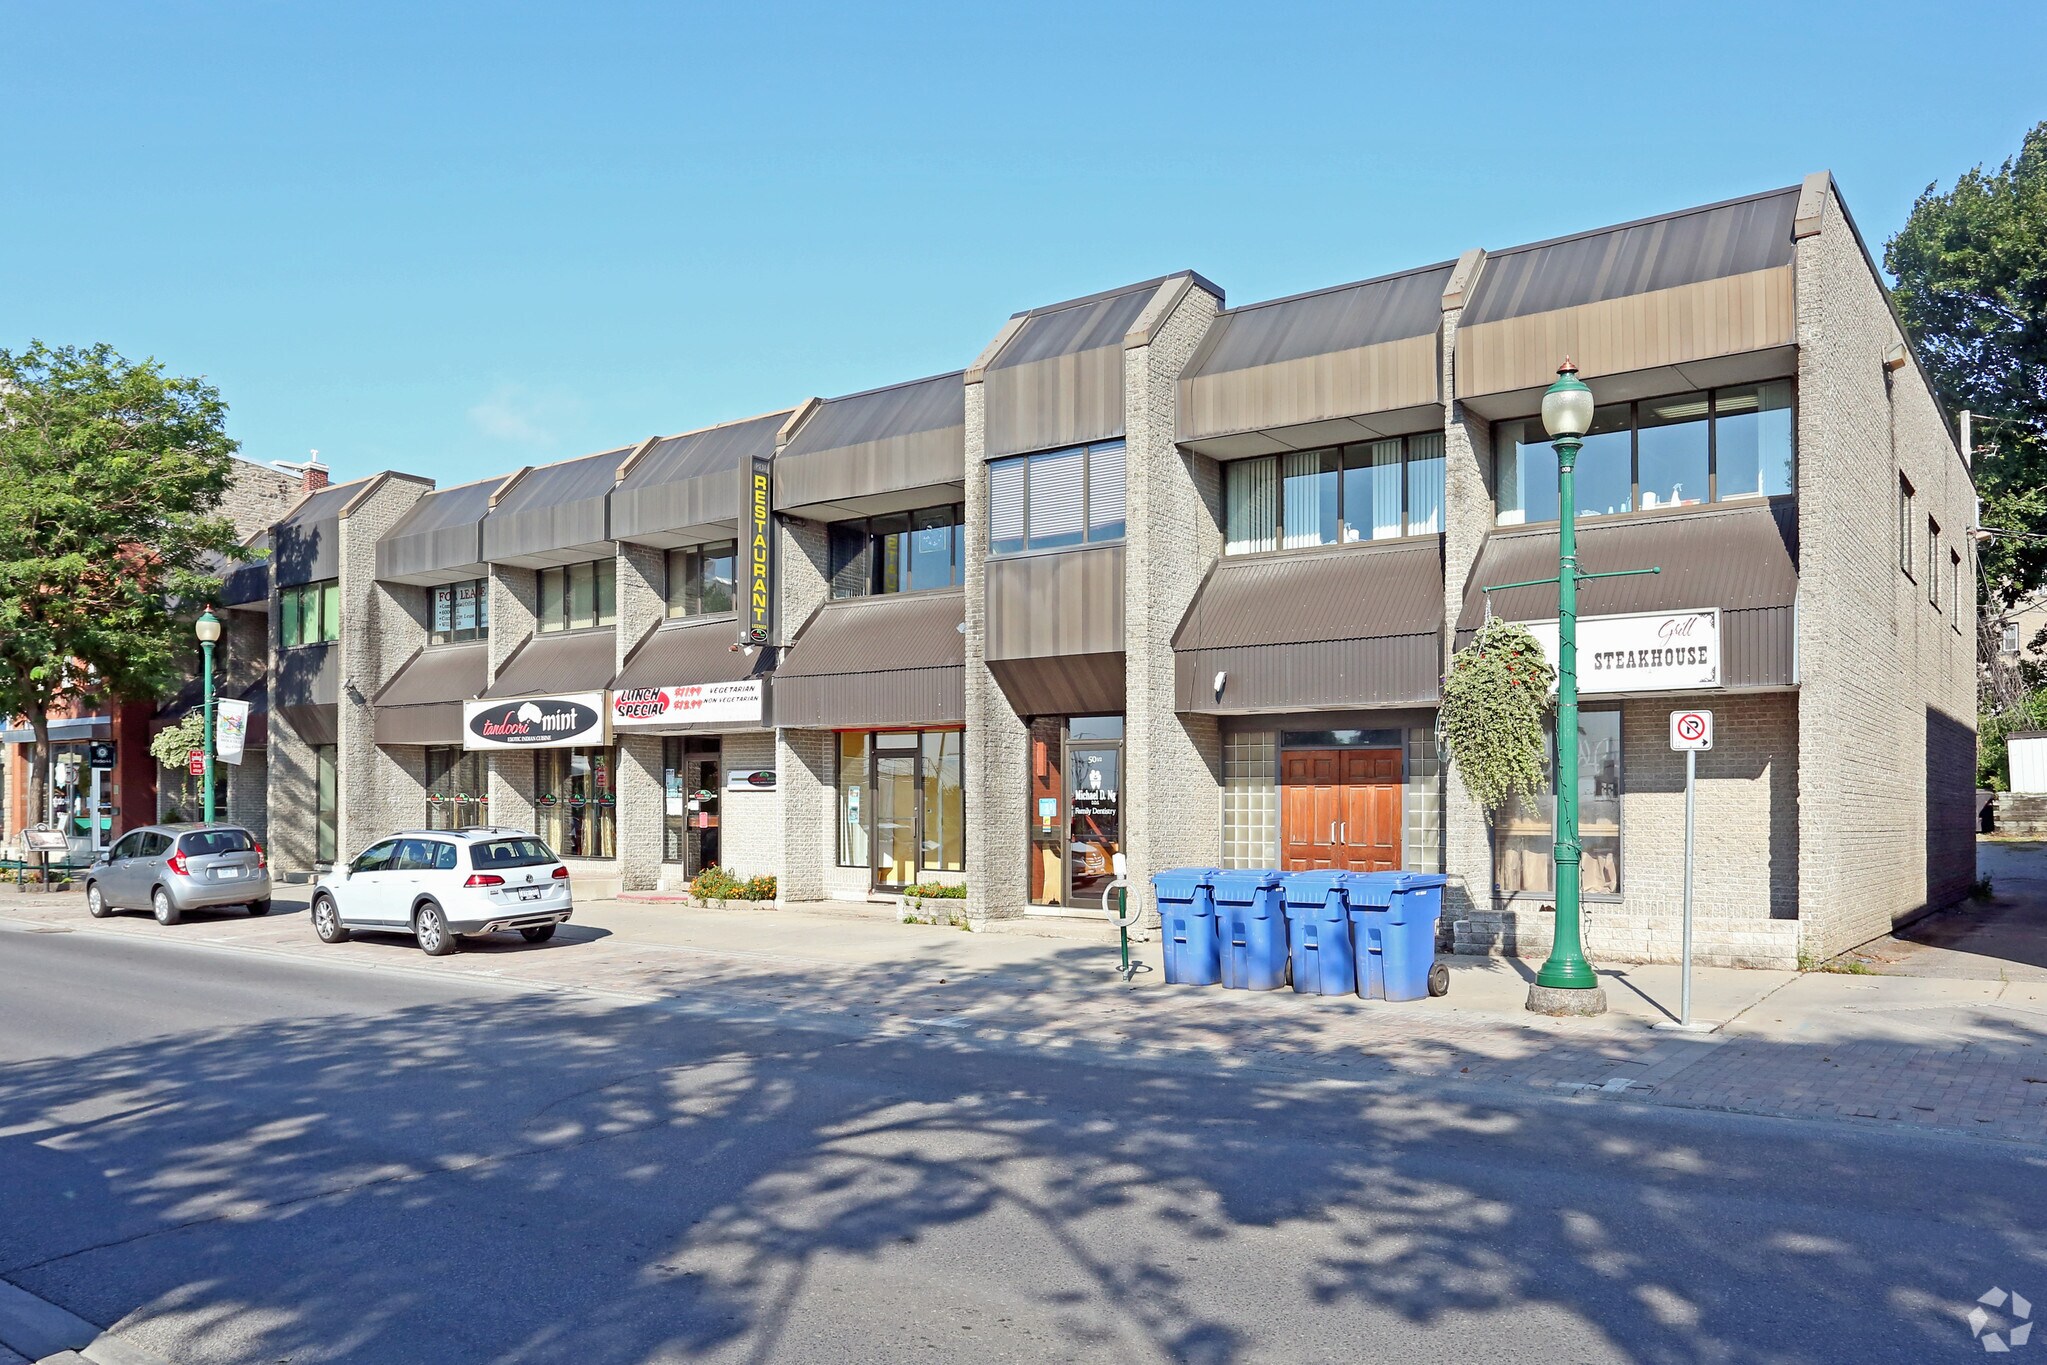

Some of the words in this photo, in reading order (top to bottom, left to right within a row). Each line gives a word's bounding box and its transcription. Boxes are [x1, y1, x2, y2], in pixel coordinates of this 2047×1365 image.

[753, 474, 767, 622] RESTAURANT
[1658, 617, 1698, 647] Grill
[1594, 646, 1708, 670] STEAKHOUSE
[621, 688, 661, 702] LUNCH
[709, 685, 756, 694] VEGETARIAN
[617, 703, 665, 717] SPECIAL
[482, 710, 530, 735] tandoori
[542, 707, 578, 732] mint
[1075, 789, 1099, 801] Michael
[1099, 789, 1106, 801] D.
[1107, 789, 1117, 803] Ng
[1074, 807, 1091, 816] Family
[1092, 807, 1117, 816] Dentistry
